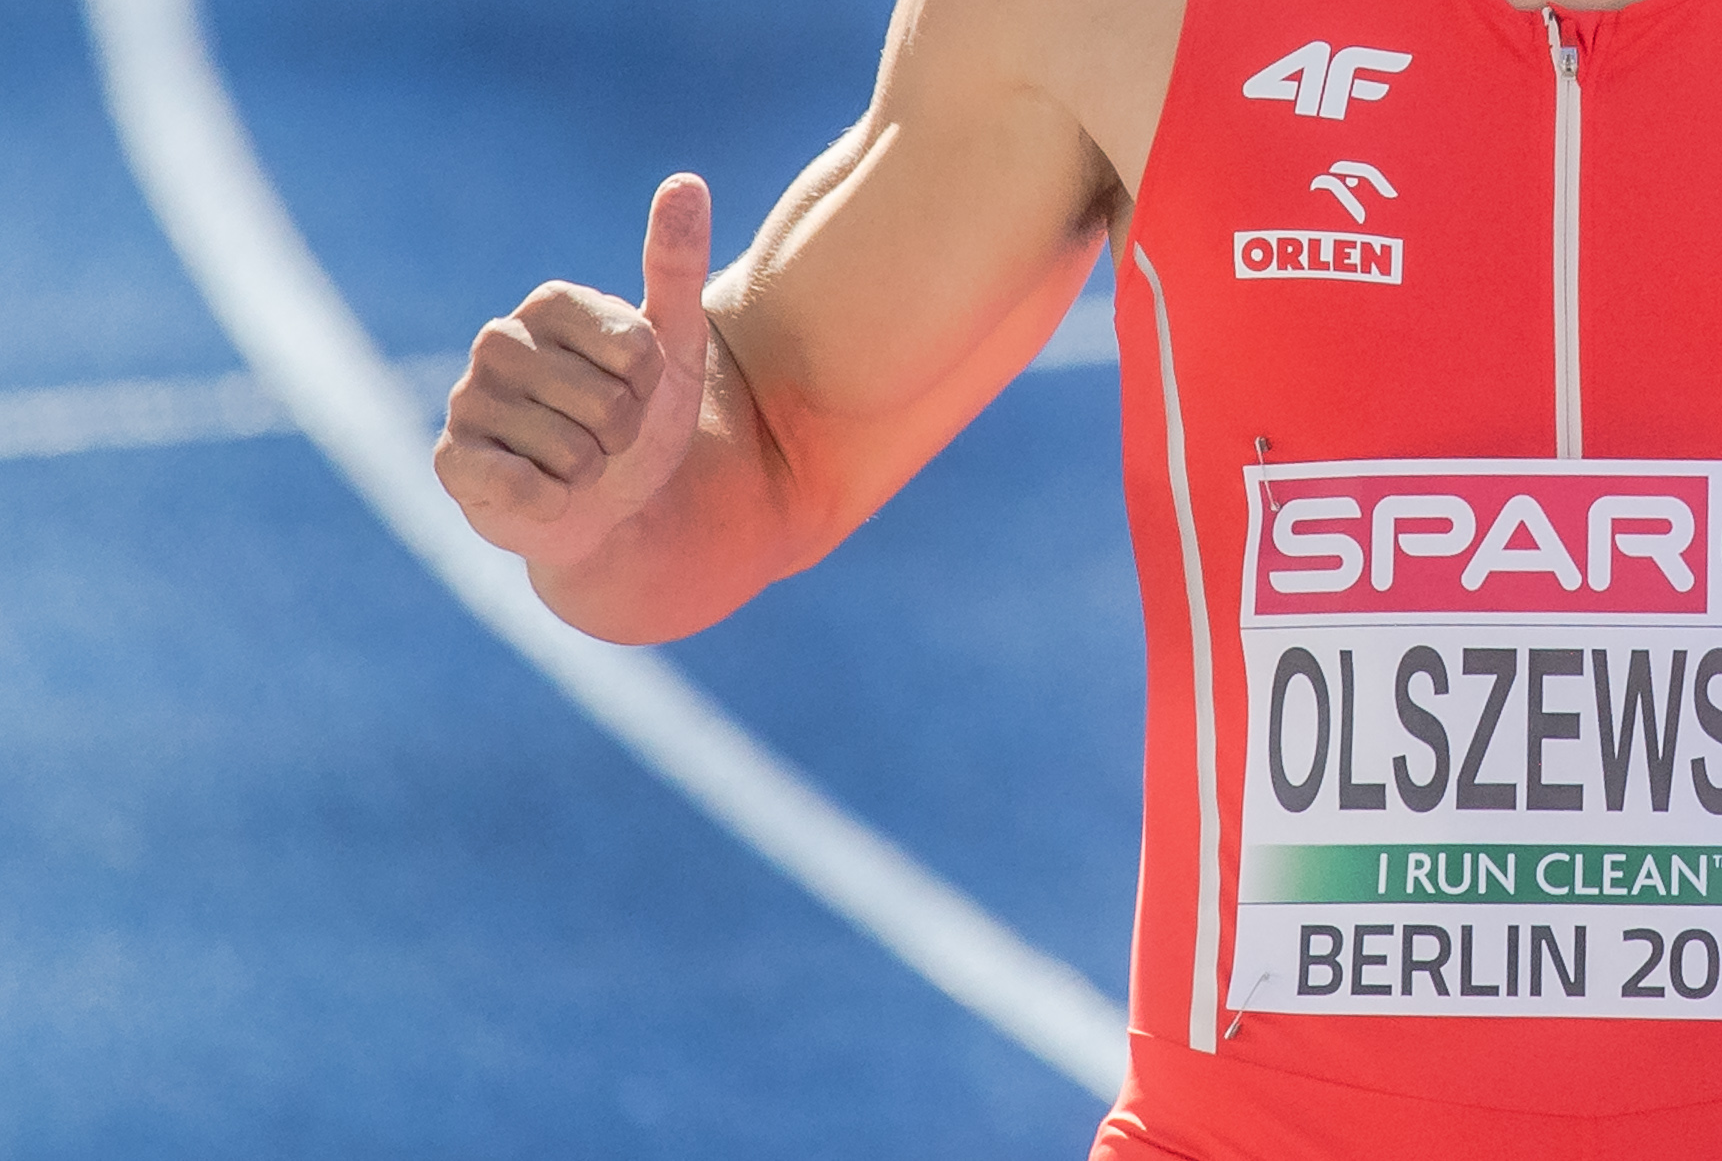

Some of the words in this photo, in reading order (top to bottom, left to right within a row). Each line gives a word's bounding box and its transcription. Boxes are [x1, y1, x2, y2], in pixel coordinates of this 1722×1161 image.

[1242, 40, 1413, 120] 4F
[1241, 236, 1393, 277] ORLEN
[1269, 494, 1696, 594] SPAR
[1377, 852, 1389, 895] I
[1406, 852, 1515, 896] RUN
[1296, 924, 1588, 998] BERLIN
